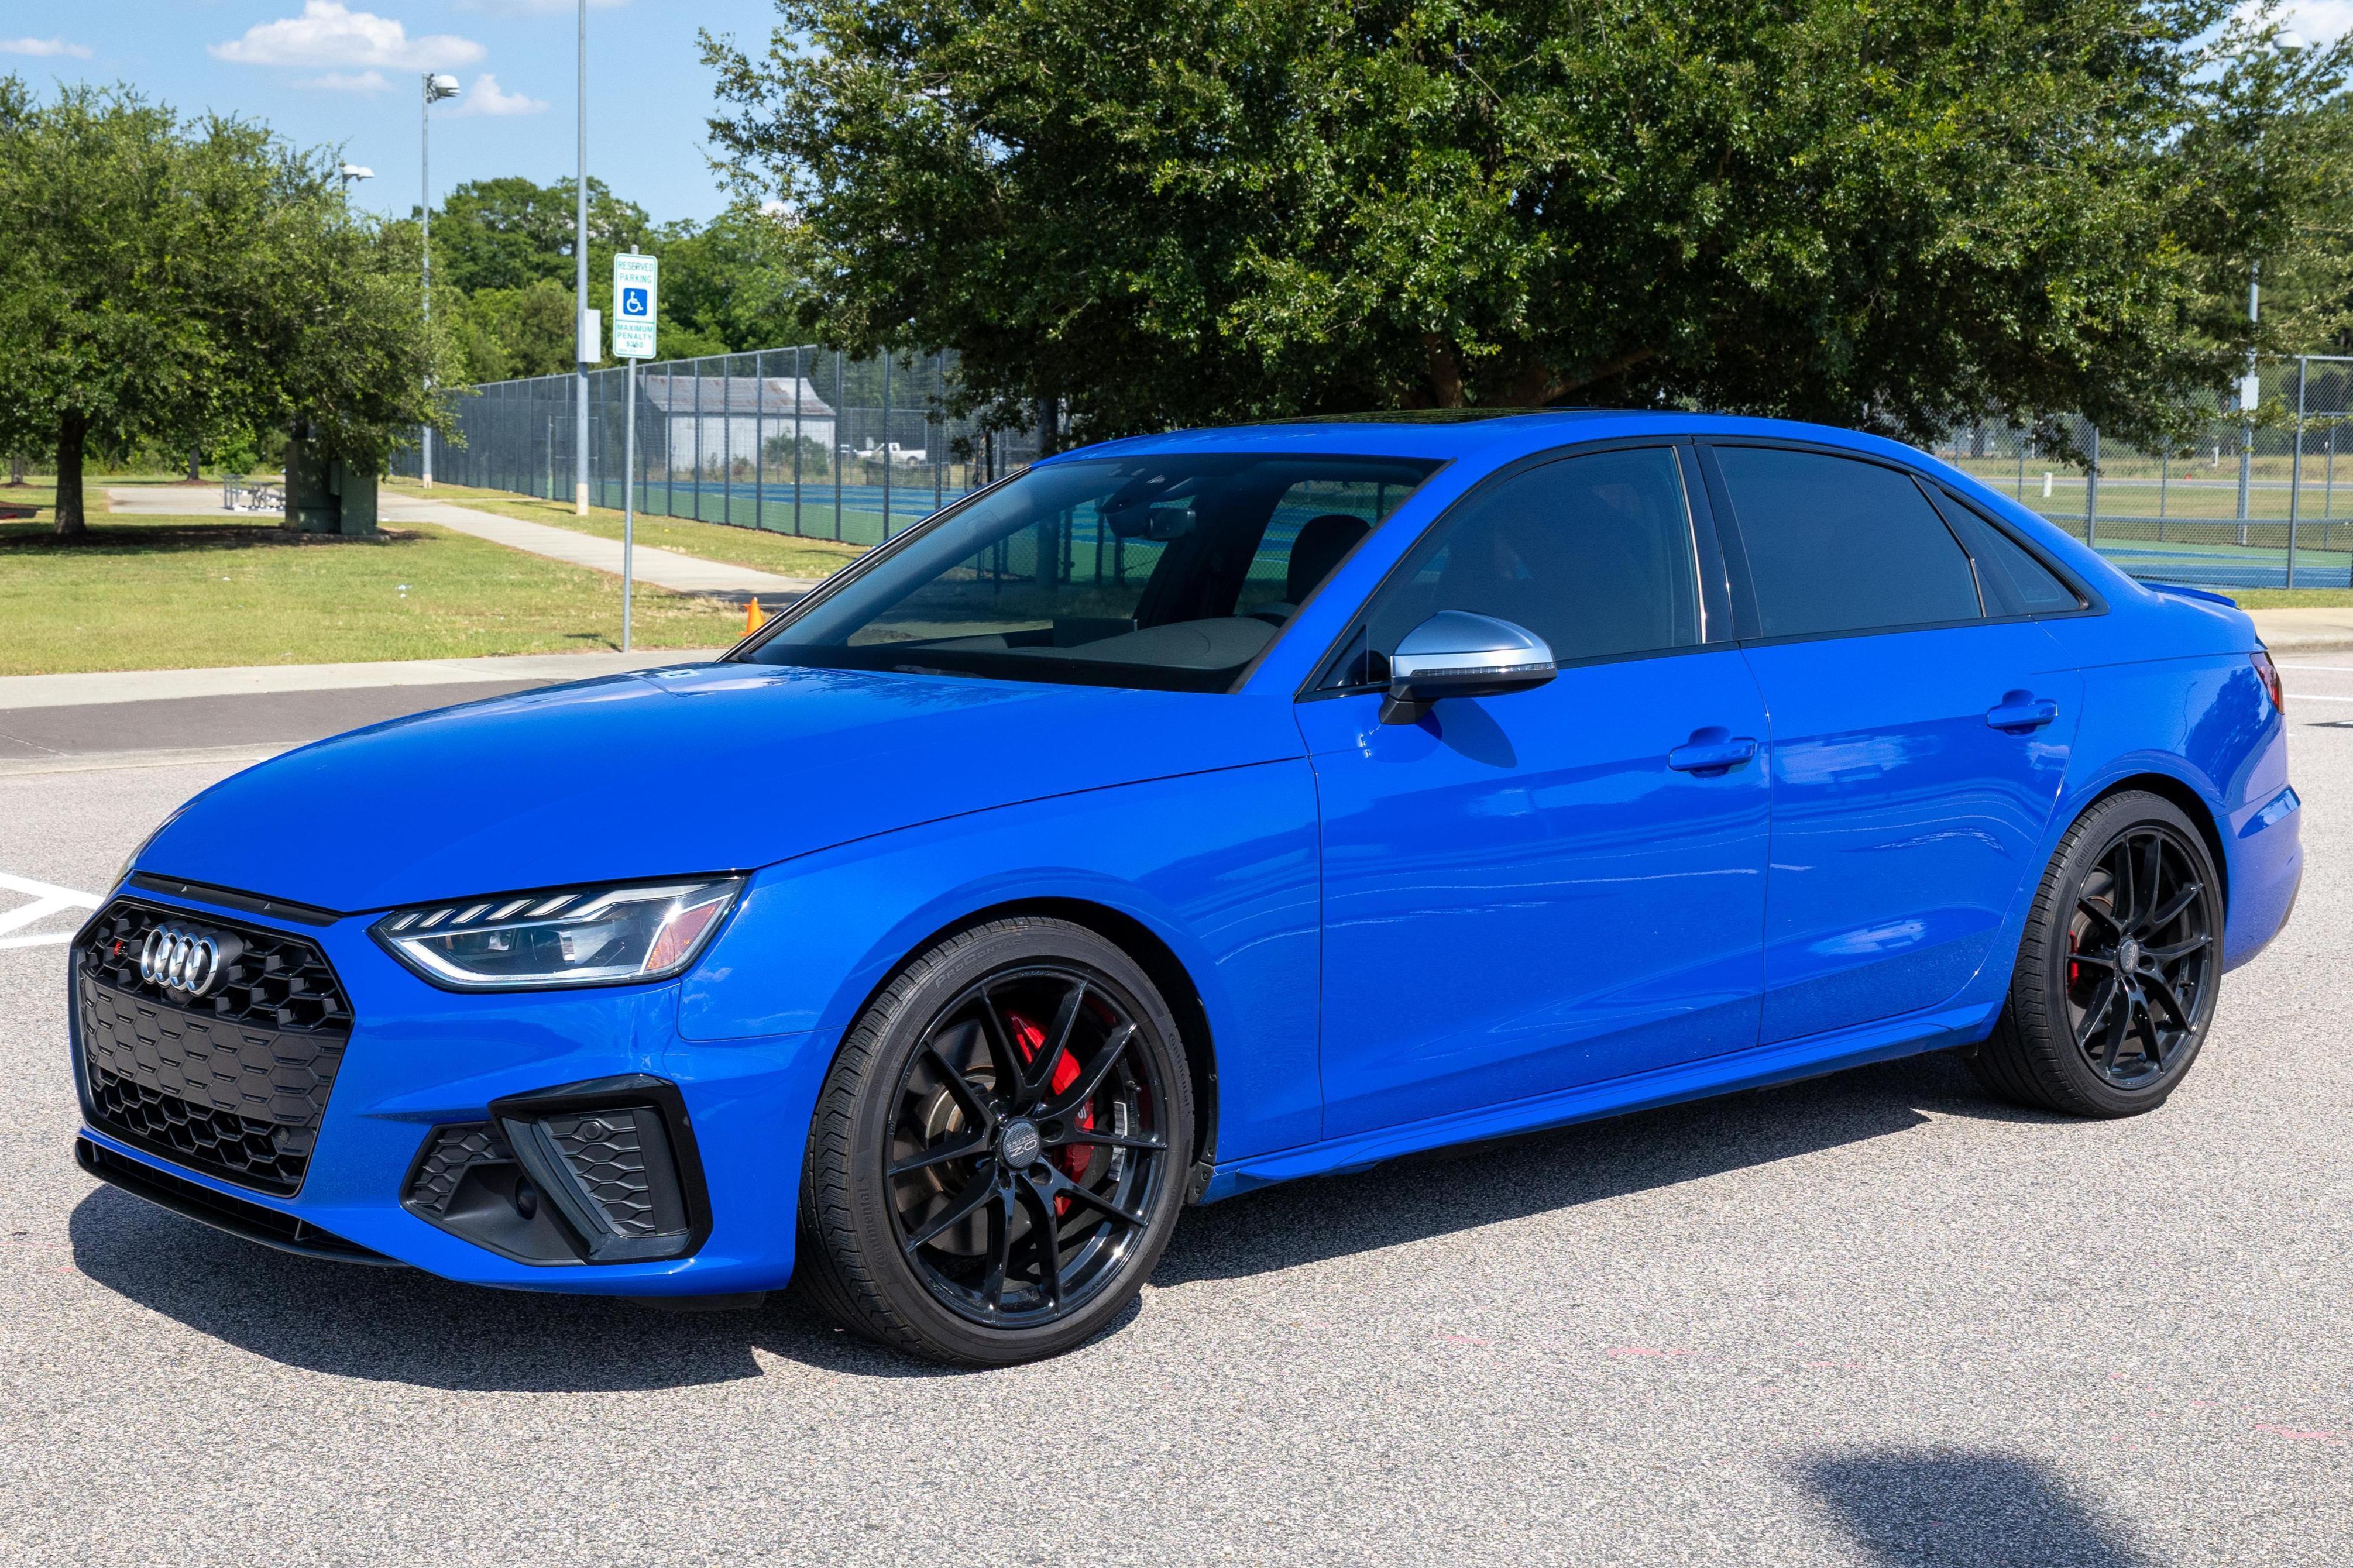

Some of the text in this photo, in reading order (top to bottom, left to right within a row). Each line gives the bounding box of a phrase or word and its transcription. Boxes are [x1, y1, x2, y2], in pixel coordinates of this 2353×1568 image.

[618, 261, 654, 272] RESERVED
[620, 273, 652, 284] PARKING
[617, 324, 653, 333] MAXIMUM
[617, 332, 652, 341] PENALTY
[857, 1188, 889, 1268] Continental
